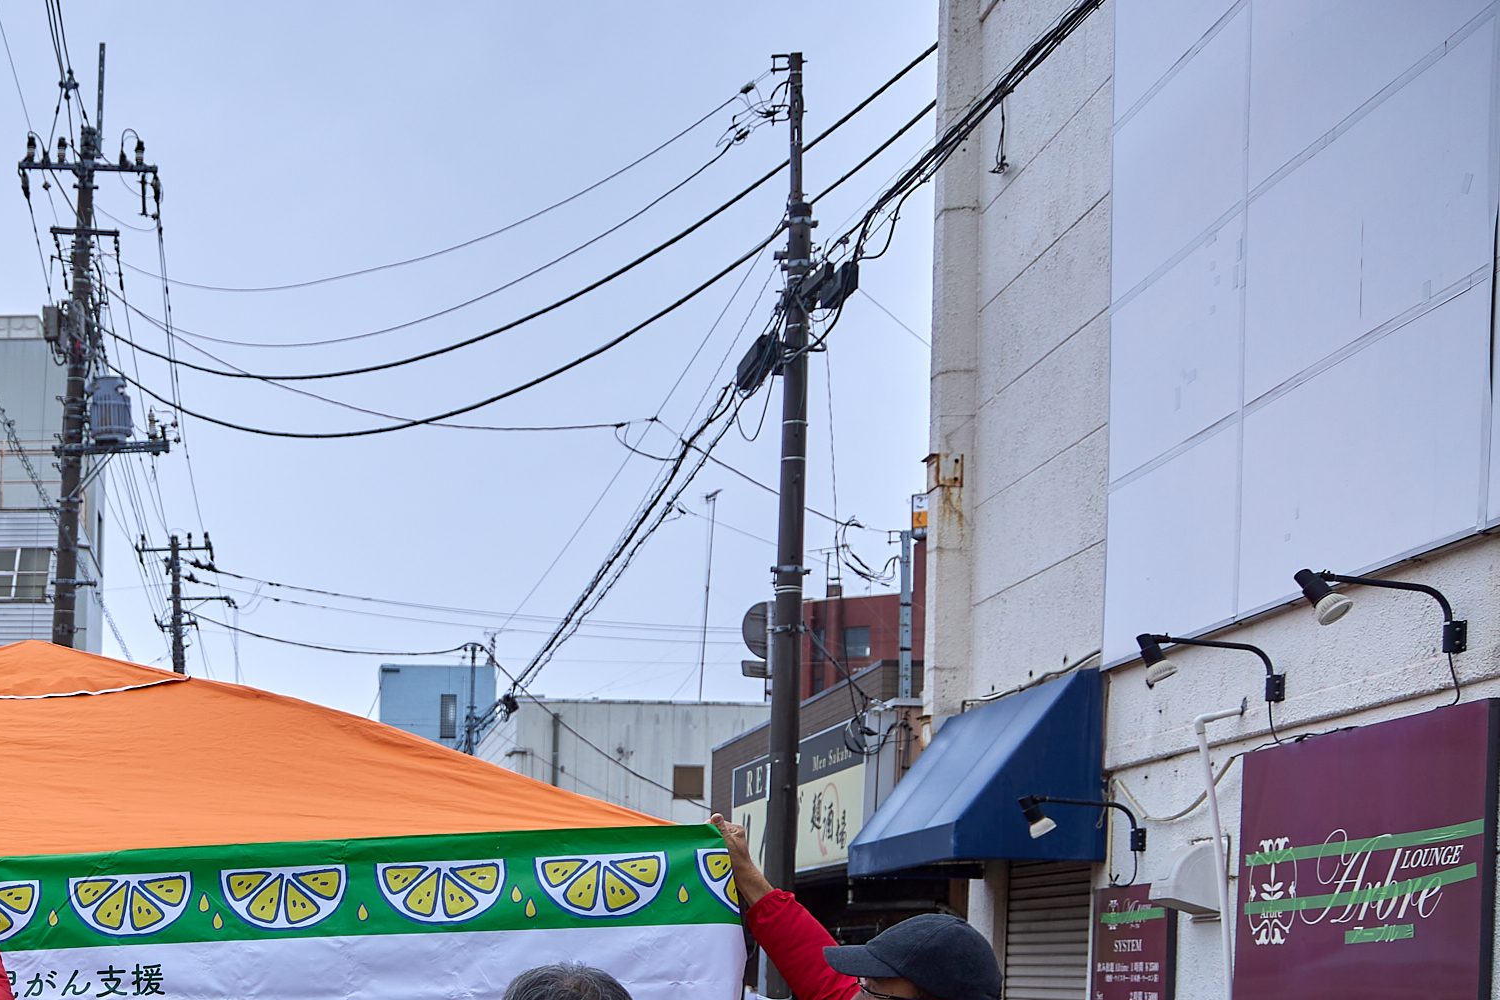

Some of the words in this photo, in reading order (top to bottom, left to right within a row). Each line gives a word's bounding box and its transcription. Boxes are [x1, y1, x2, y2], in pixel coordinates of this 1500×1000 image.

[812, 755, 827, 772] Men
[1400, 844, 1464, 869] LOUNGE
[1299, 828, 1443, 925] Arbre
[1113, 938, 1143, 952] SYSTEM
